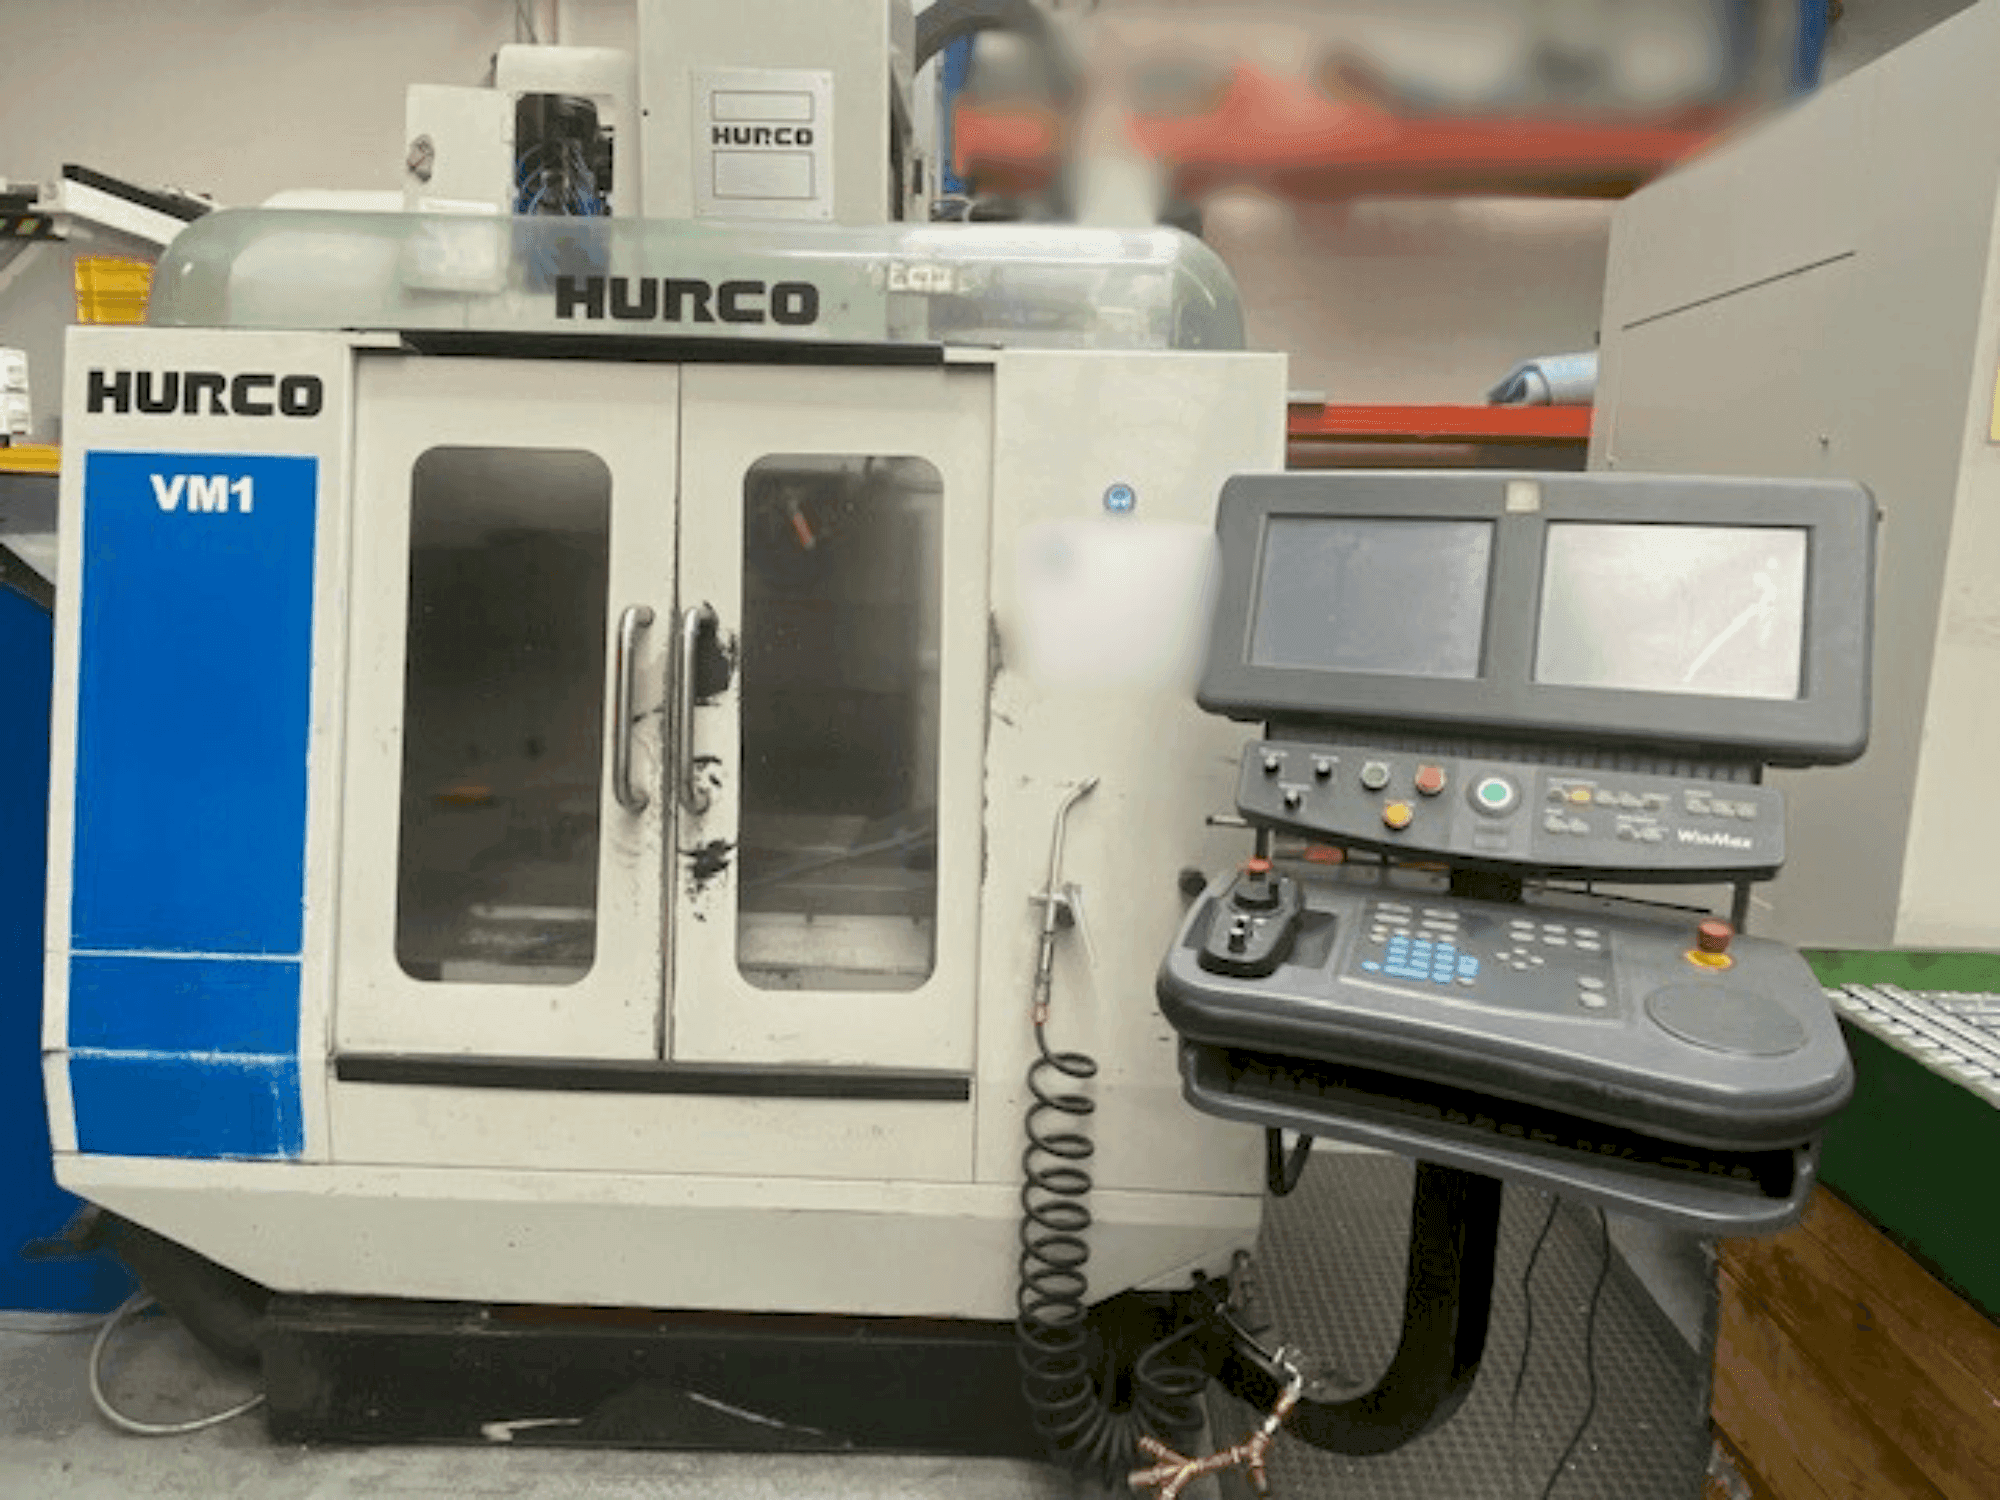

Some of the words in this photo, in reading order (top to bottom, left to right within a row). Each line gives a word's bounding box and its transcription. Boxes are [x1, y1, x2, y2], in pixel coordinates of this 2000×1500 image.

[712, 126, 814, 147] HURCO
[554, 273, 820, 326] HURCO
[87, 369, 324, 418] HURCO
[149, 474, 255, 514] VM1
